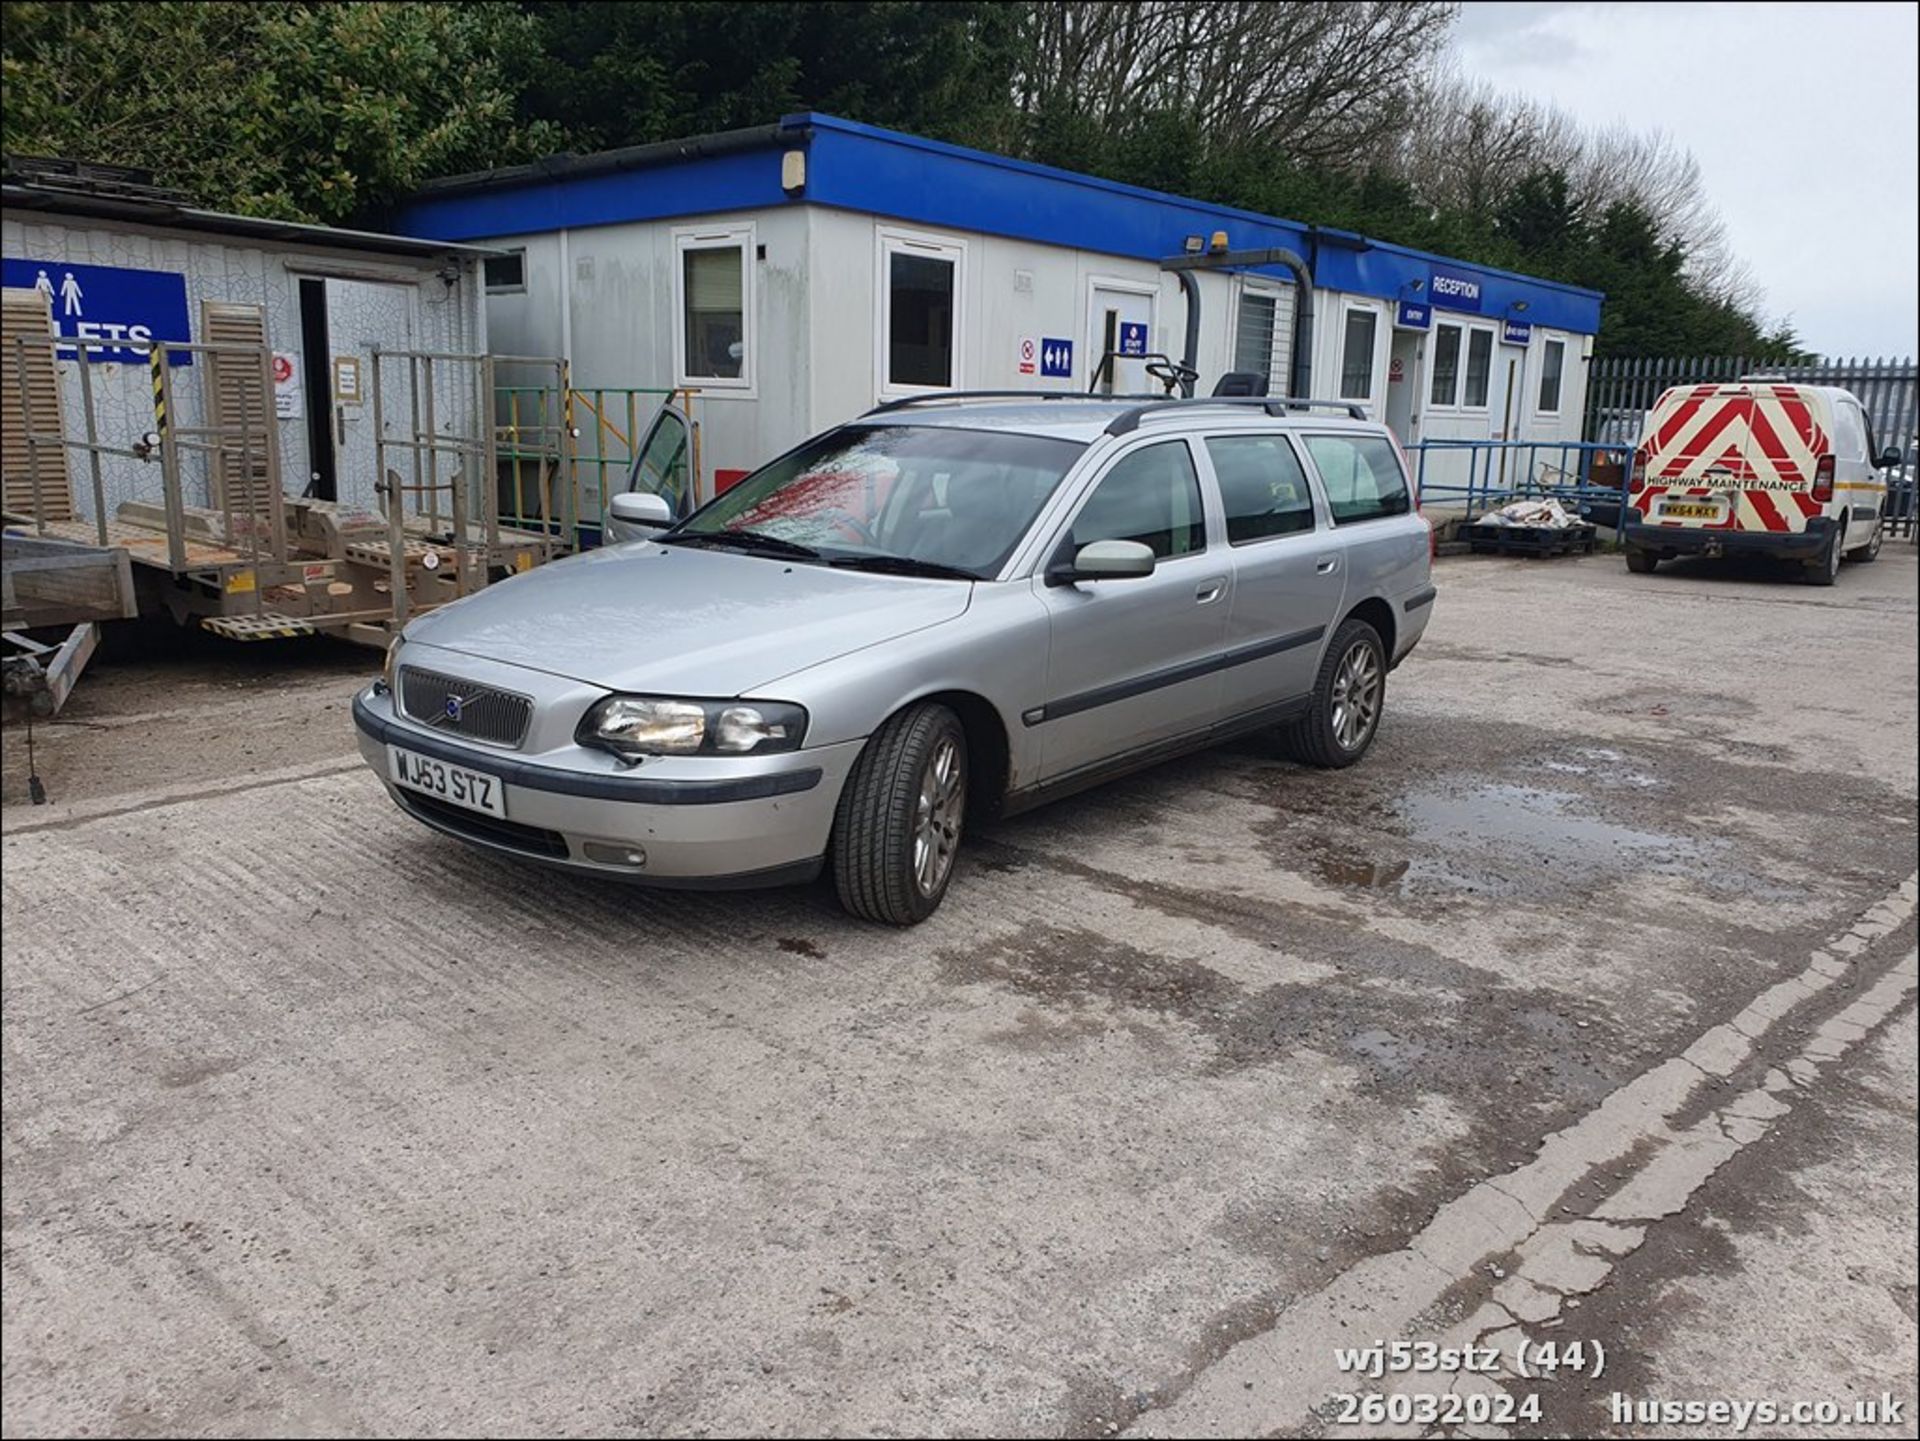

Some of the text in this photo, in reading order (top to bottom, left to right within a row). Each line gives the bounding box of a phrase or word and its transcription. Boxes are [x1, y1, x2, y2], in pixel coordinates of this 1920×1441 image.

[1432, 276, 1480, 299] RECEPTION
[53, 320, 152, 355] LETS
[1646, 476, 1808, 491] HIGHWAY MAINTENANCE
[396, 750, 494, 810] WJ53 STZ
